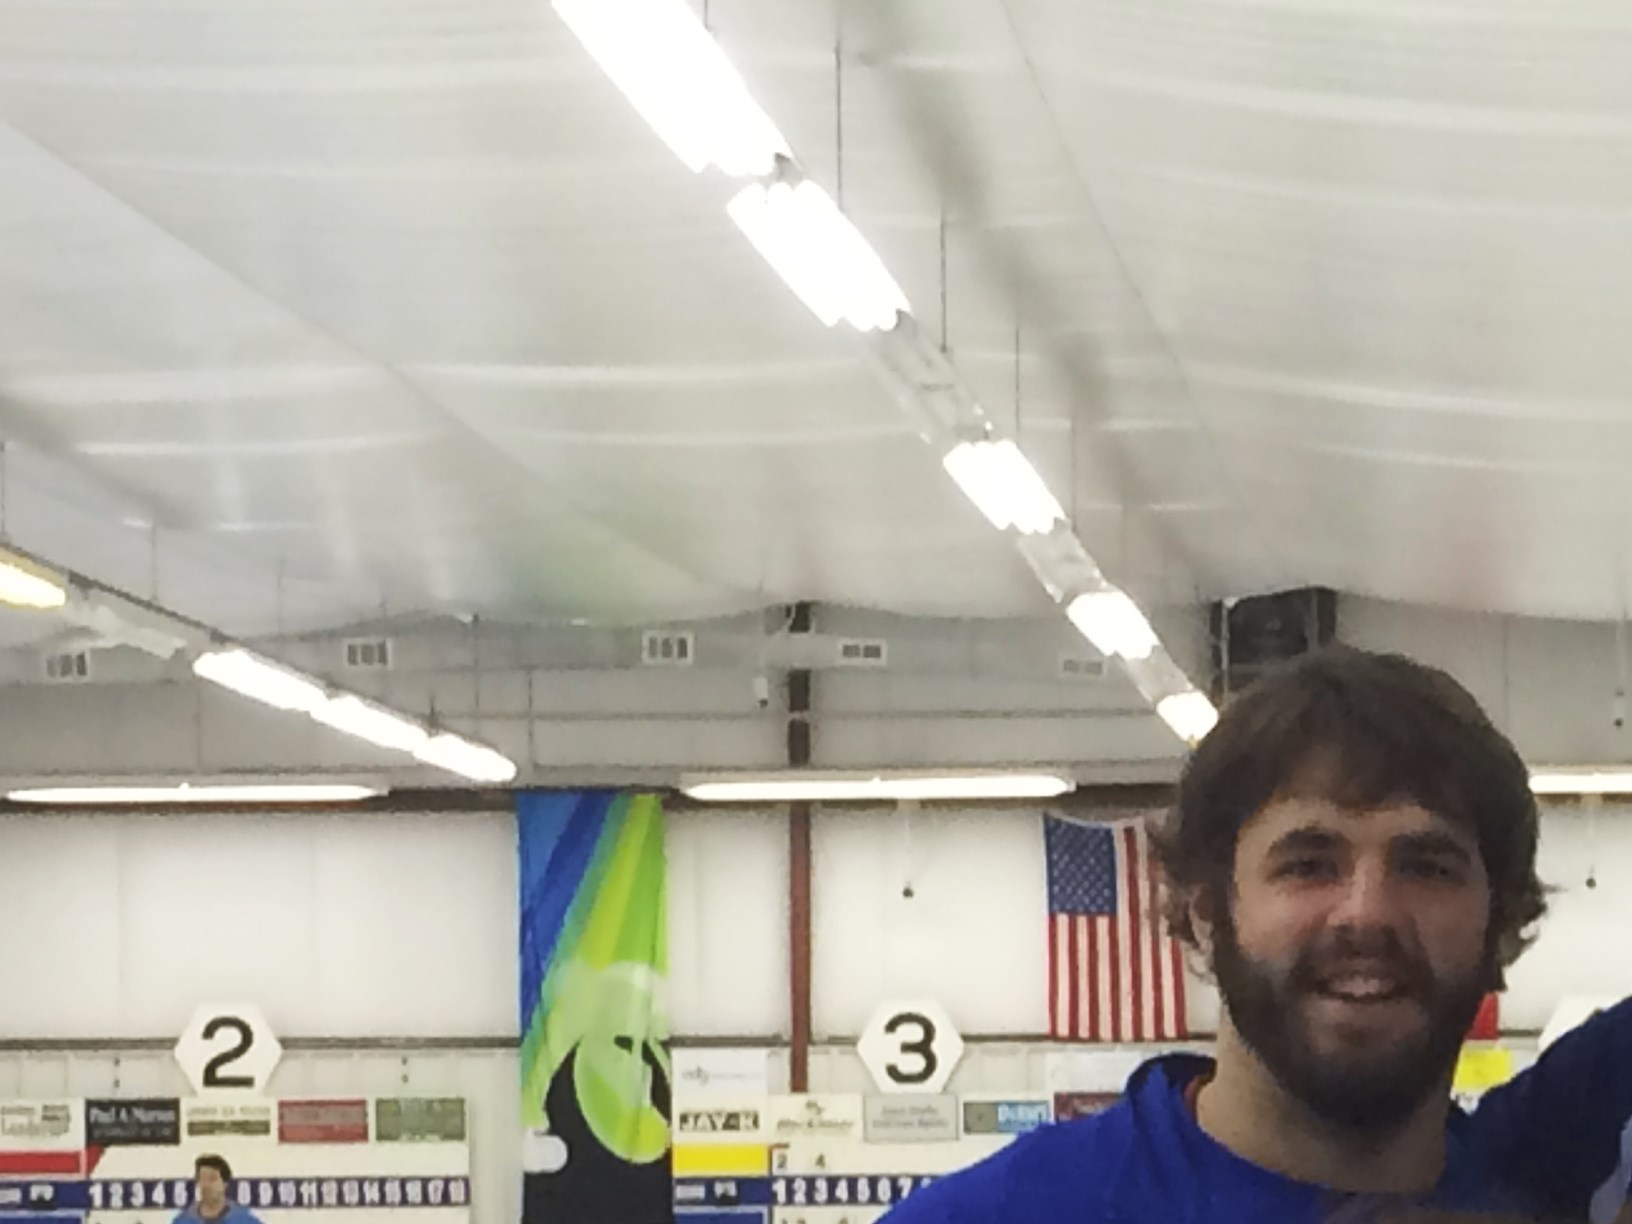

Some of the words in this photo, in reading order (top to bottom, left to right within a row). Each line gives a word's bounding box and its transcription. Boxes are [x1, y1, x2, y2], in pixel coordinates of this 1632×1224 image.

[202, 1017, 254, 1087] 2
[885, 1013, 937, 1083] 3
[90, 1181, 103, 1207] 1
[109, 1181, 123, 1207] 2
[131, 1181, 145, 1207] 3
[152, 1181, 166, 1207] 4
[771, 1179, 787, 1204] 1
[793, 1179, 806, 1204] 2
[814, 1179, 828, 1204] 3
[835, 1179, 848, 1204] 4
